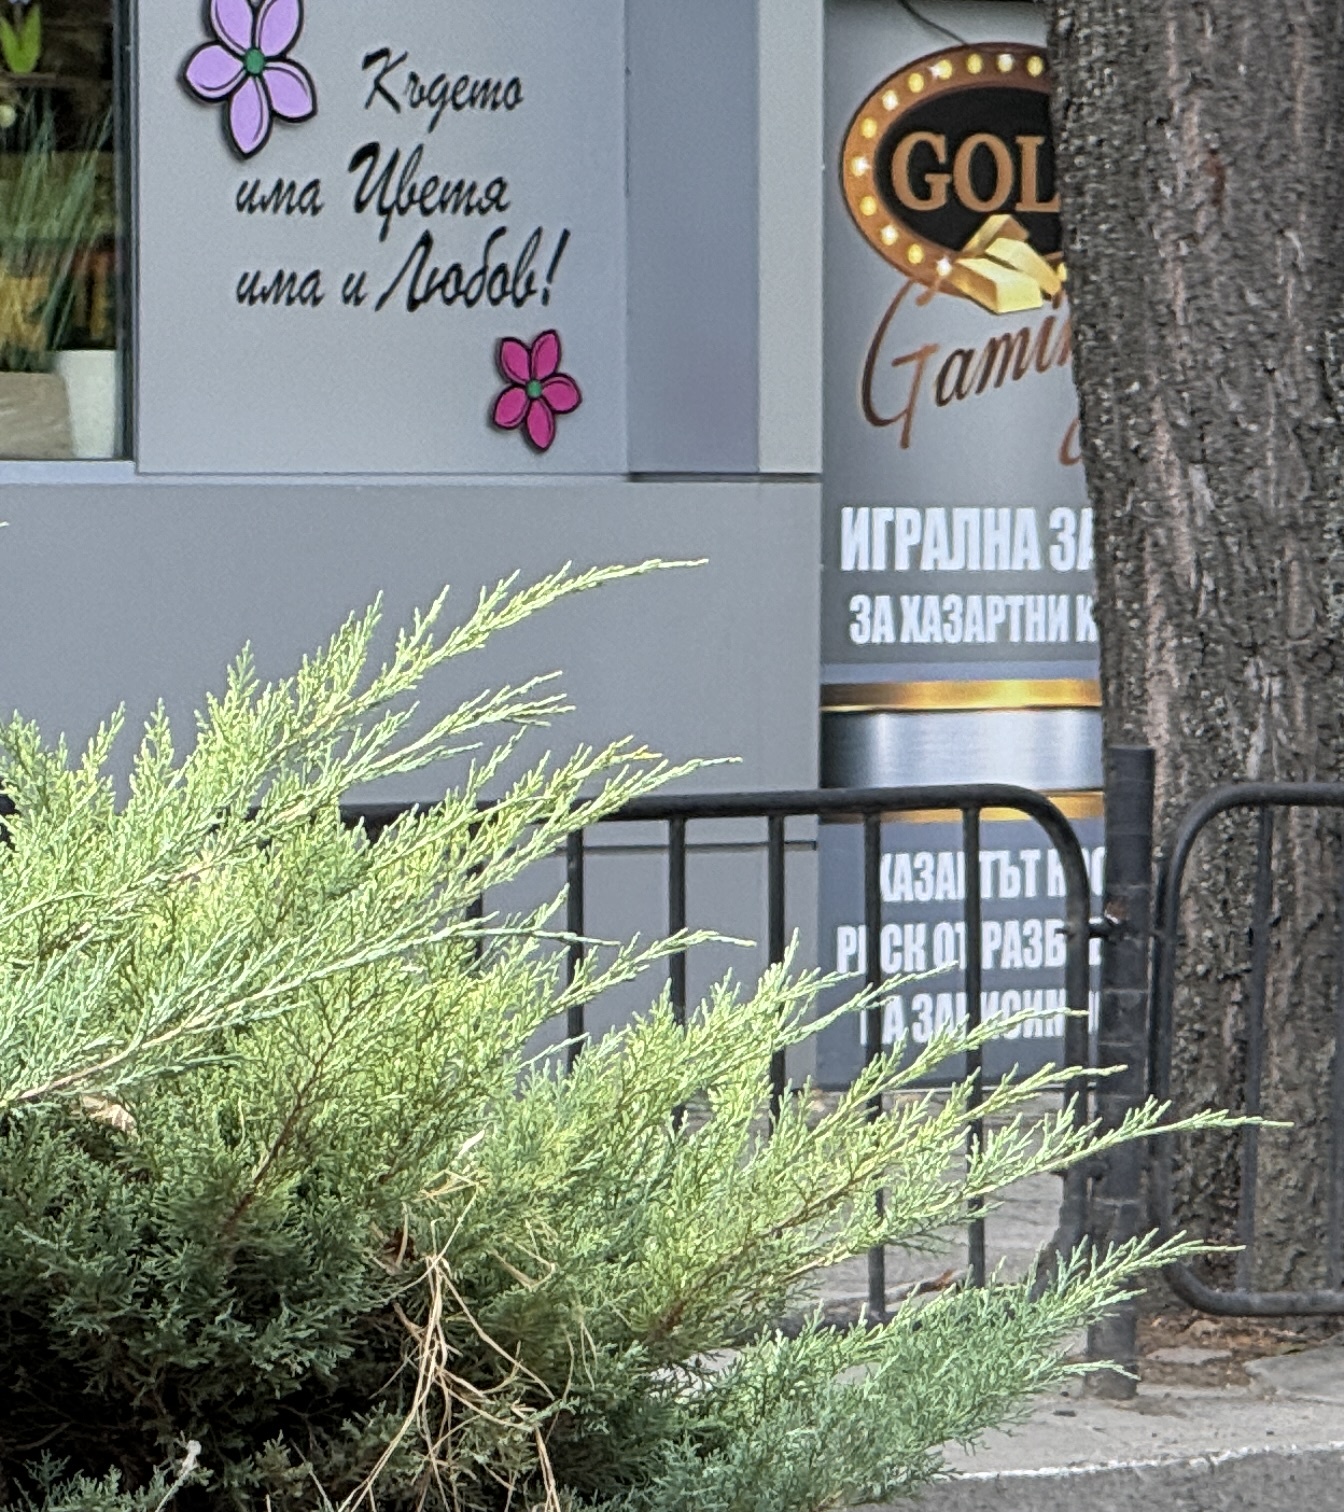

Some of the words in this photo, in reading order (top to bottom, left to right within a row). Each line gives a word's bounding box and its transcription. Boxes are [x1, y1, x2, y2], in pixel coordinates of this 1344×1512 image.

[362, 47, 524, 134] Където
[236, 178, 325, 216] има
[348, 141, 511, 243] Цветя
[891, 131, 1061, 212] GOL
[236, 269, 325, 307] има
[342, 271, 368, 307] и
[375, 225, 571, 313] Любов!
[841, 506, 1042, 572] ИГРАЛНА
[850, 594, 896, 645] ЗА
[900, 594, 1069, 644] ХАЗАРТНИ
